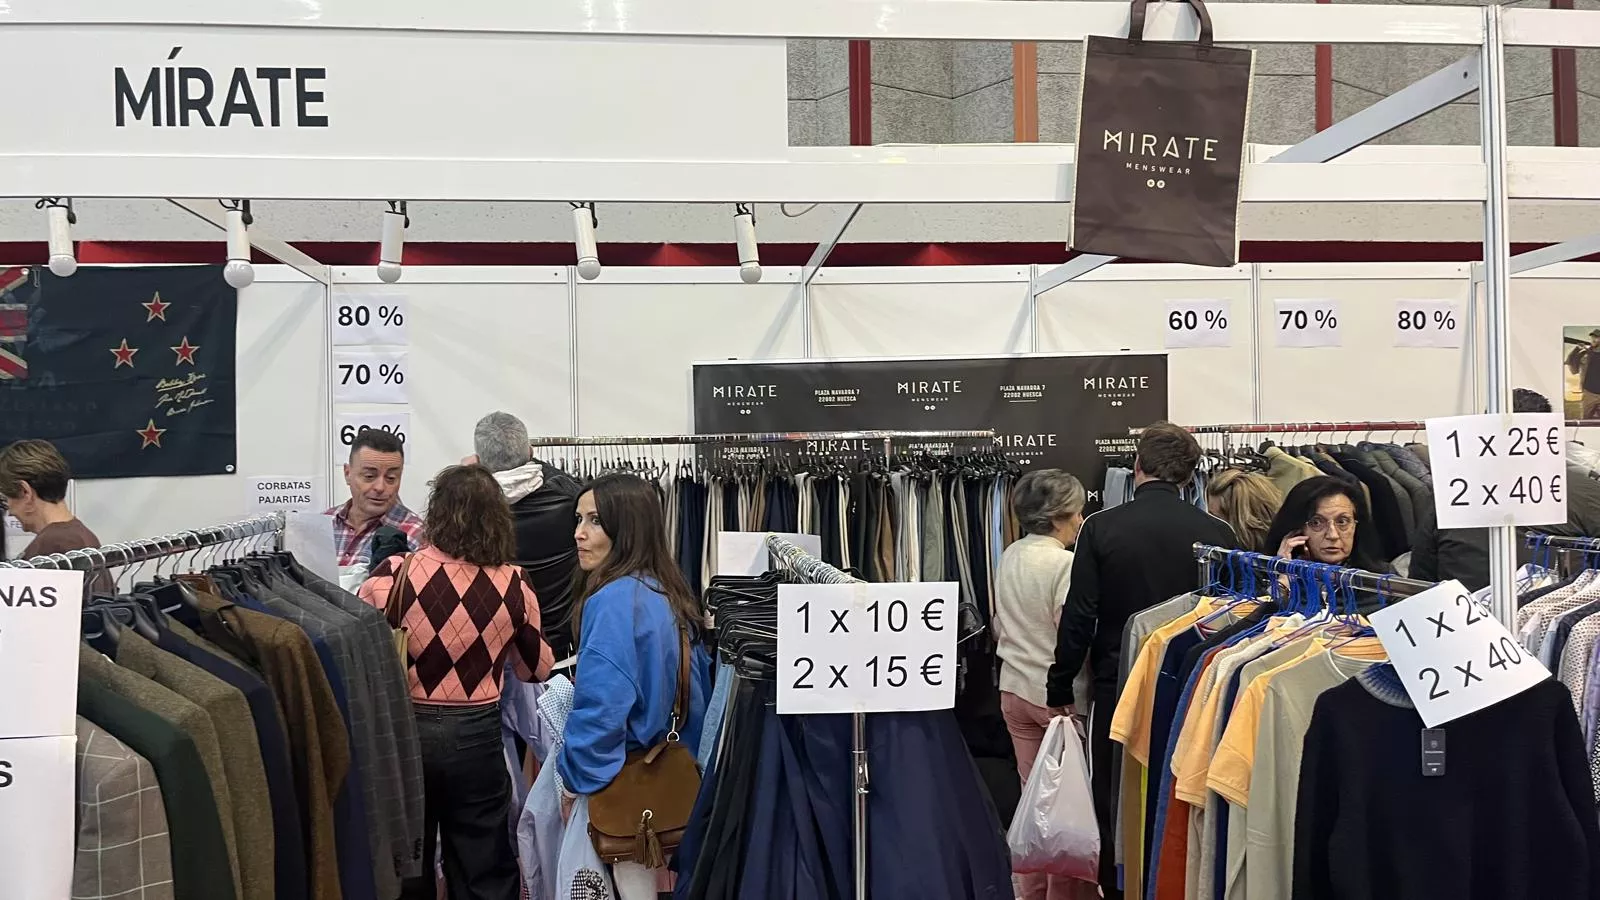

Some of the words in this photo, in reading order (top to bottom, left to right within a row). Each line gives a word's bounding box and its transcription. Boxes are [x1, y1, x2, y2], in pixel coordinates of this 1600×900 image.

[115, 46, 329, 127] MÍRATE
[1103, 129, 1219, 161] MIRATE
[1126, 162, 1192, 175] MENSWEAR
[338, 306, 370, 327] 80
[378, 306, 403, 327] %
[1168, 310, 1198, 330] 60
[1204, 310, 1228, 330] %
[1279, 310, 1308, 330] 70
[1314, 310, 1337, 329] %
[1397, 311, 1426, 330] 80
[1433, 310, 1456, 330] %
[339, 364, 371, 385] 70
[379, 364, 404, 384] %
[1084, 376, 1149, 390] MIRATE
[713, 385, 777, 398] MIRATE
[897, 381, 962, 394] MIRATE
[340, 424, 371, 445] 6
[992, 434, 1057, 447] MIRATE
[1446, 430, 1460, 458] 1
[1478, 435, 1497, 457] x
[1508, 427, 1540, 456] 25
[1547, 427, 1559, 455] €
[257, 481, 311, 490] CORBATAS
[1449, 478, 1470, 506] 2
[1481, 484, 1499, 505] x
[1509, 476, 1543, 504] 40
[1550, 475, 1562, 503] €
[258, 495, 311, 504] PAJARITAS
[796, 601, 810, 634] 1
[829, 609, 850, 633] x
[866, 599, 908, 633] 10
[921, 598, 945, 632] €
[1395, 618, 1417, 648] 1
[1425, 611, 1456, 639] x
[792, 657, 814, 689] 2
[828, 664, 849, 689] x
[865, 655, 907, 688] 15
[920, 653, 944, 686] €
[1418, 667, 1450, 700] 2
[1454, 660, 1483, 688] x
[1488, 636, 1521, 671] 40
